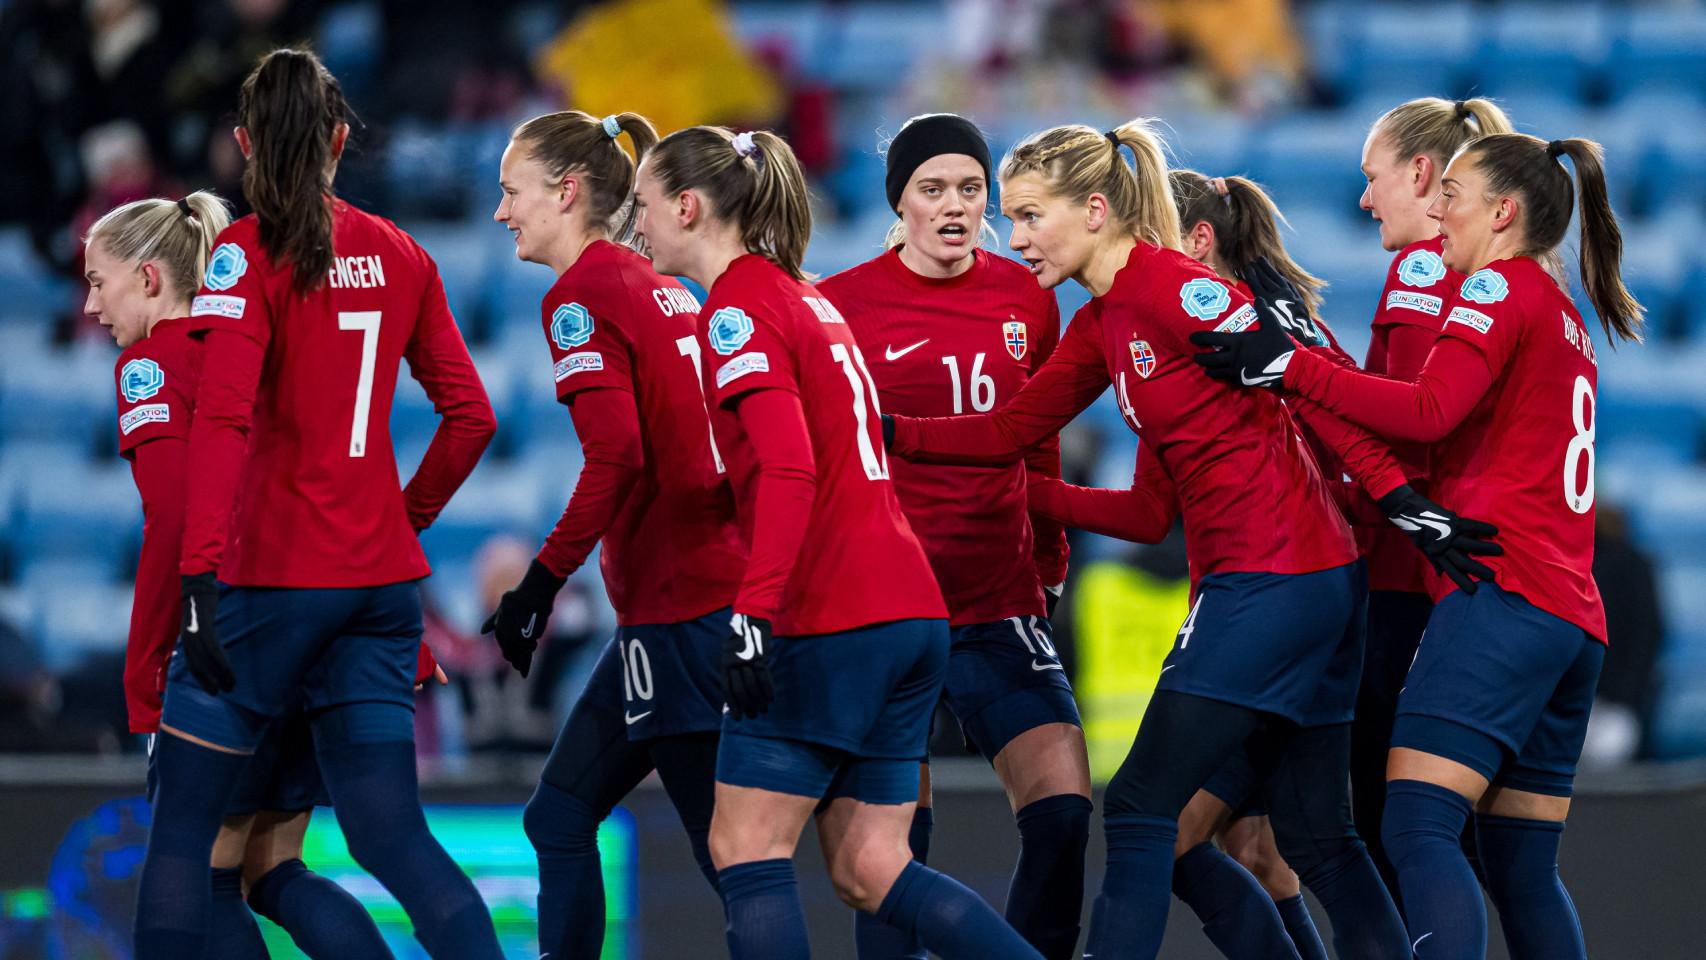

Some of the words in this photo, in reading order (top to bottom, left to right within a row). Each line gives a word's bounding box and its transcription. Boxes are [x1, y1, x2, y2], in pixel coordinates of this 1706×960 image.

[329, 255, 386, 289] ENGEN
[338, 311, 382, 458] 7
[941, 352, 996, 415] 16
[1564, 375, 1596, 515] 8
[1004, 614, 1057, 657] 16
[1178, 592, 1204, 650] 4
[620, 638, 654, 702] 10
